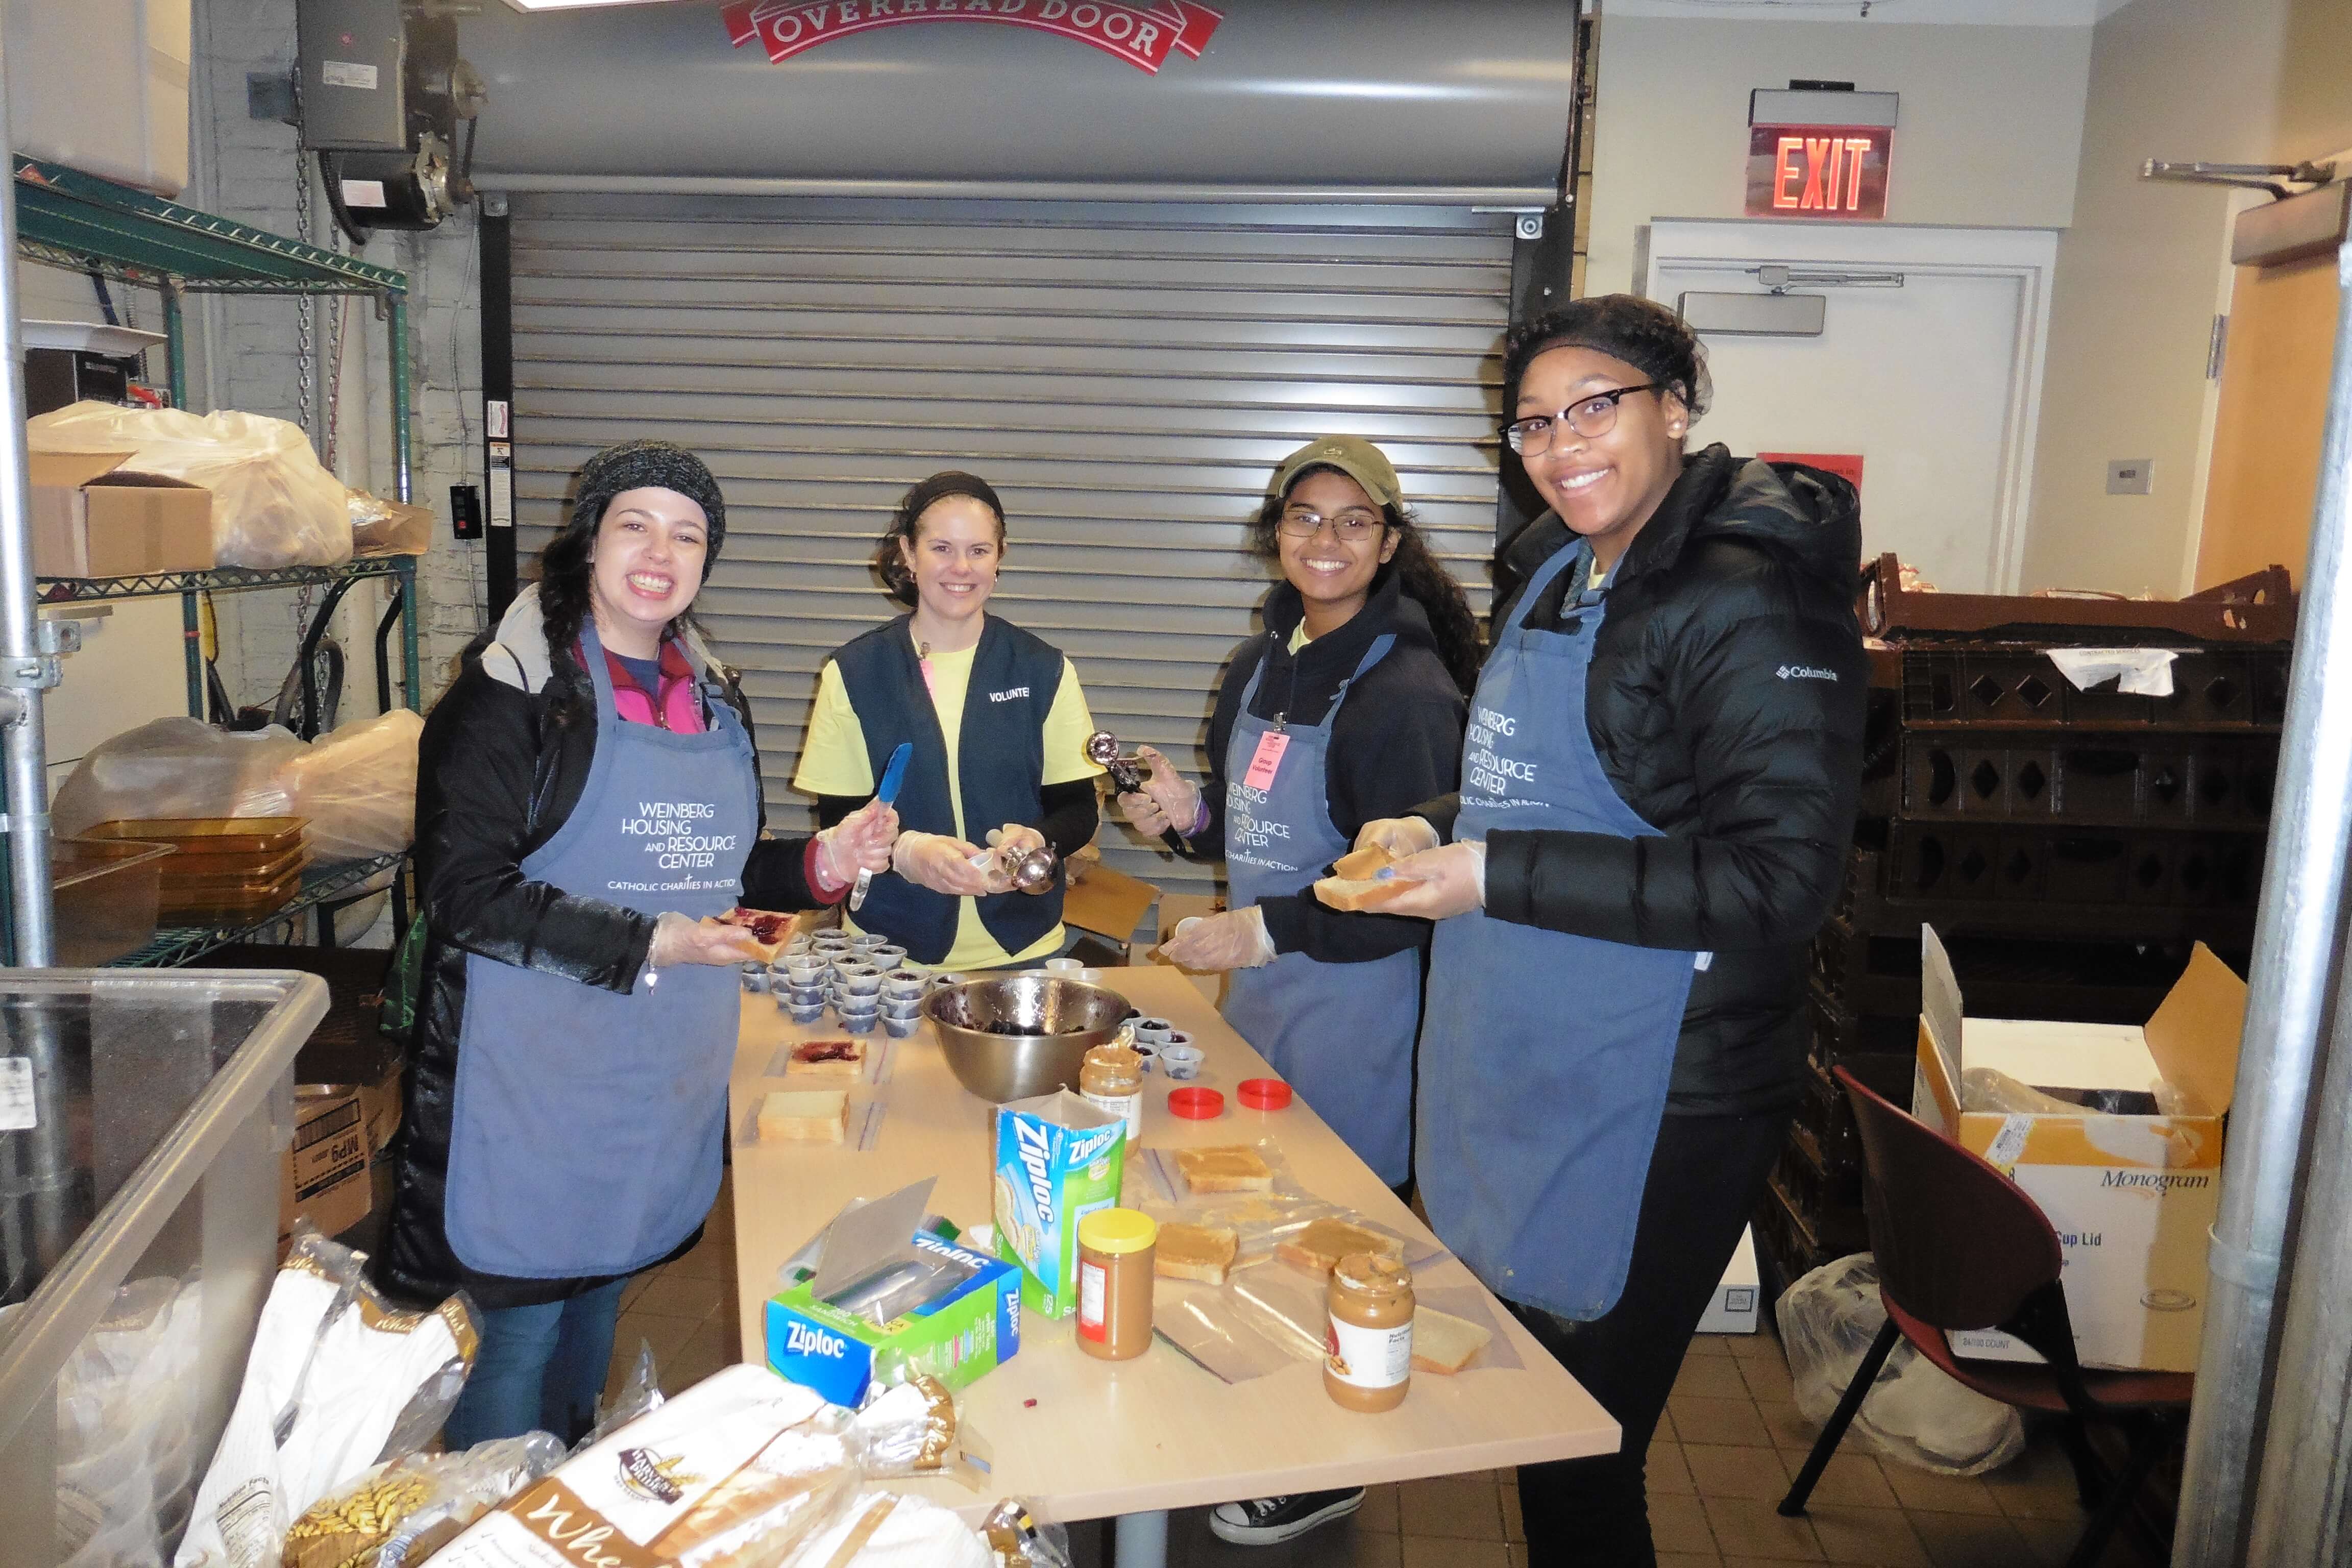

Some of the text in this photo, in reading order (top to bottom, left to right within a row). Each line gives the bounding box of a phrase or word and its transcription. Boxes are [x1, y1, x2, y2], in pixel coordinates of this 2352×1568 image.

[1038, 0, 1158, 57] DOOR
[1773, 137, 1871, 210] EXIT
[1791, 666, 1837, 681] Columbia
[1258, 757, 1272, 766] Group
[1469, 767, 1506, 796] CENTER
[639, 802, 715, 818] WEINBERG
[1226, 794, 1251, 814] OUSING
[622, 818, 692, 836] HOUSING
[1241, 813, 1290, 839] ROURCE
[645, 835, 737, 852] AND RESOURCE
[658, 853, 715, 869] CENTER
[1265, 860, 1298, 871] ACTION
[607, 873, 736, 891] CATHOLIC CHARITIES IN ACTIO
[1068, 1130, 1111, 1165] Ziploc
[1013, 1116, 1055, 1223] Ziploc
[2100, 1169, 2210, 1197] Monogram
[2082, 1232, 2102, 1246] Lid
[1006, 1287, 1020, 1337] Ziploc
[787, 1319, 845, 1358] Ziploc
[526, 1493, 673, 1568] Whe
